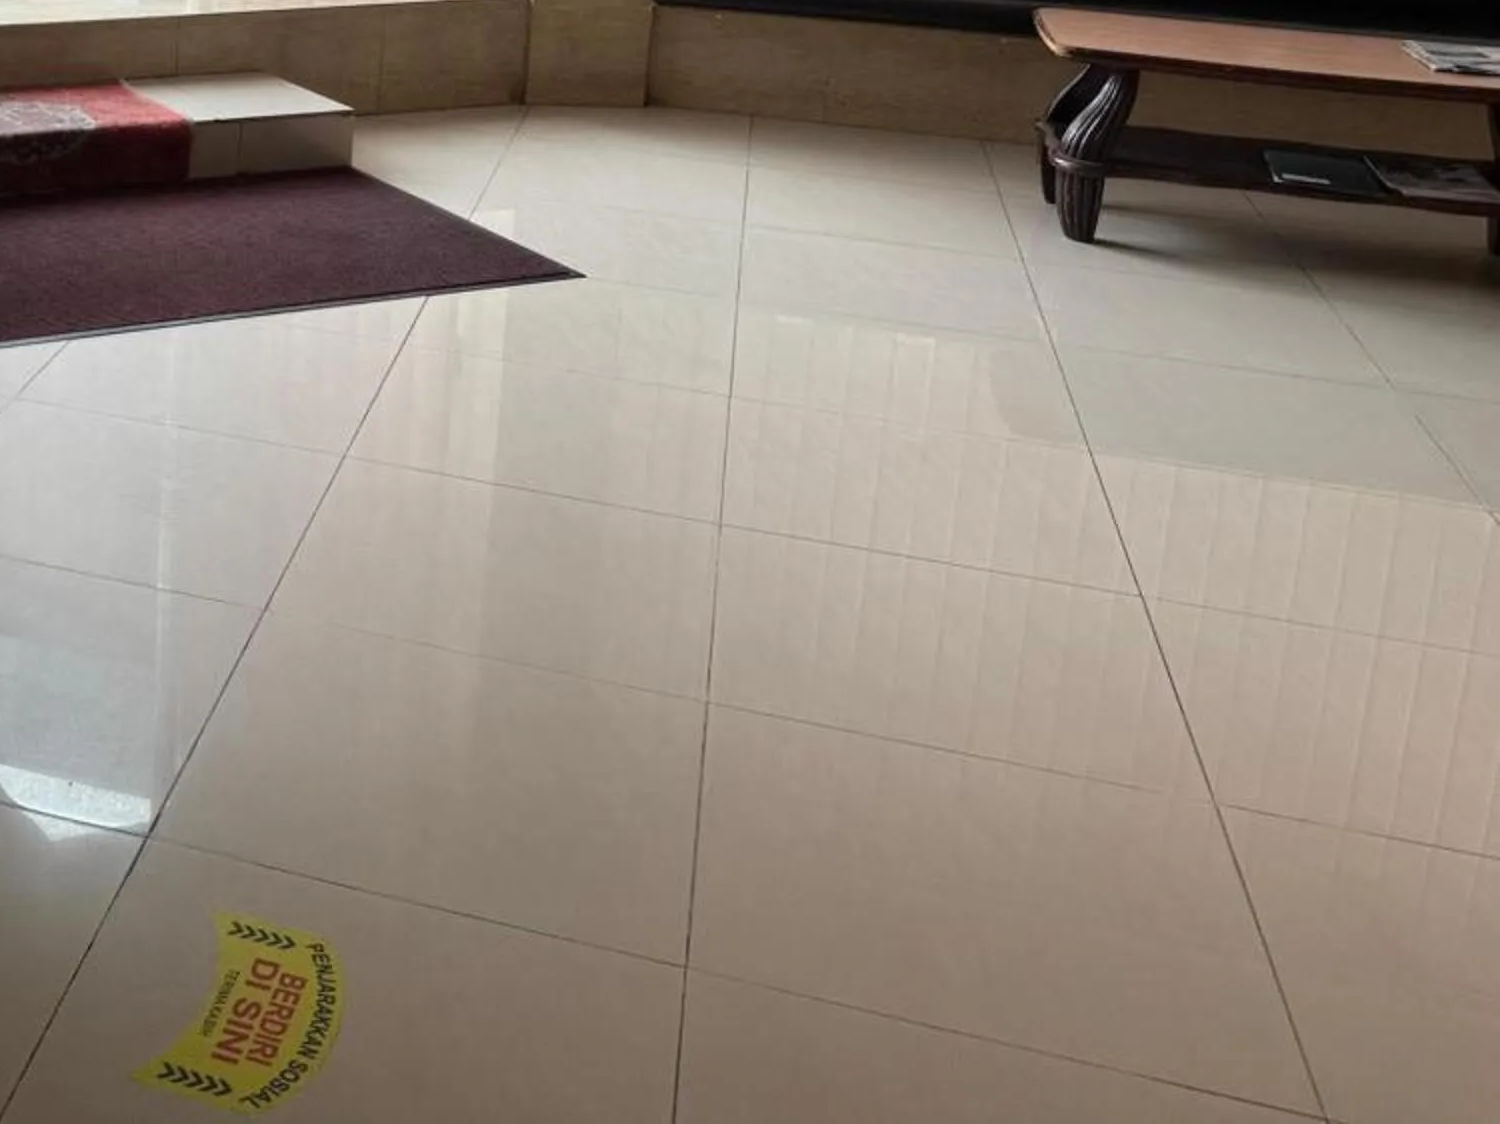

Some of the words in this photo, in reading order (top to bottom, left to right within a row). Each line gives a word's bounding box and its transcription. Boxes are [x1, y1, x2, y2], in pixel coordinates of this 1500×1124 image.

[246, 957, 280, 992] DI
[298, 943, 336, 1059] PENJARAKKAN
[211, 997, 261, 1065] SINI
[246, 972, 308, 1067] BERDIRI
[239, 1059, 309, 1108] SOSIAL
